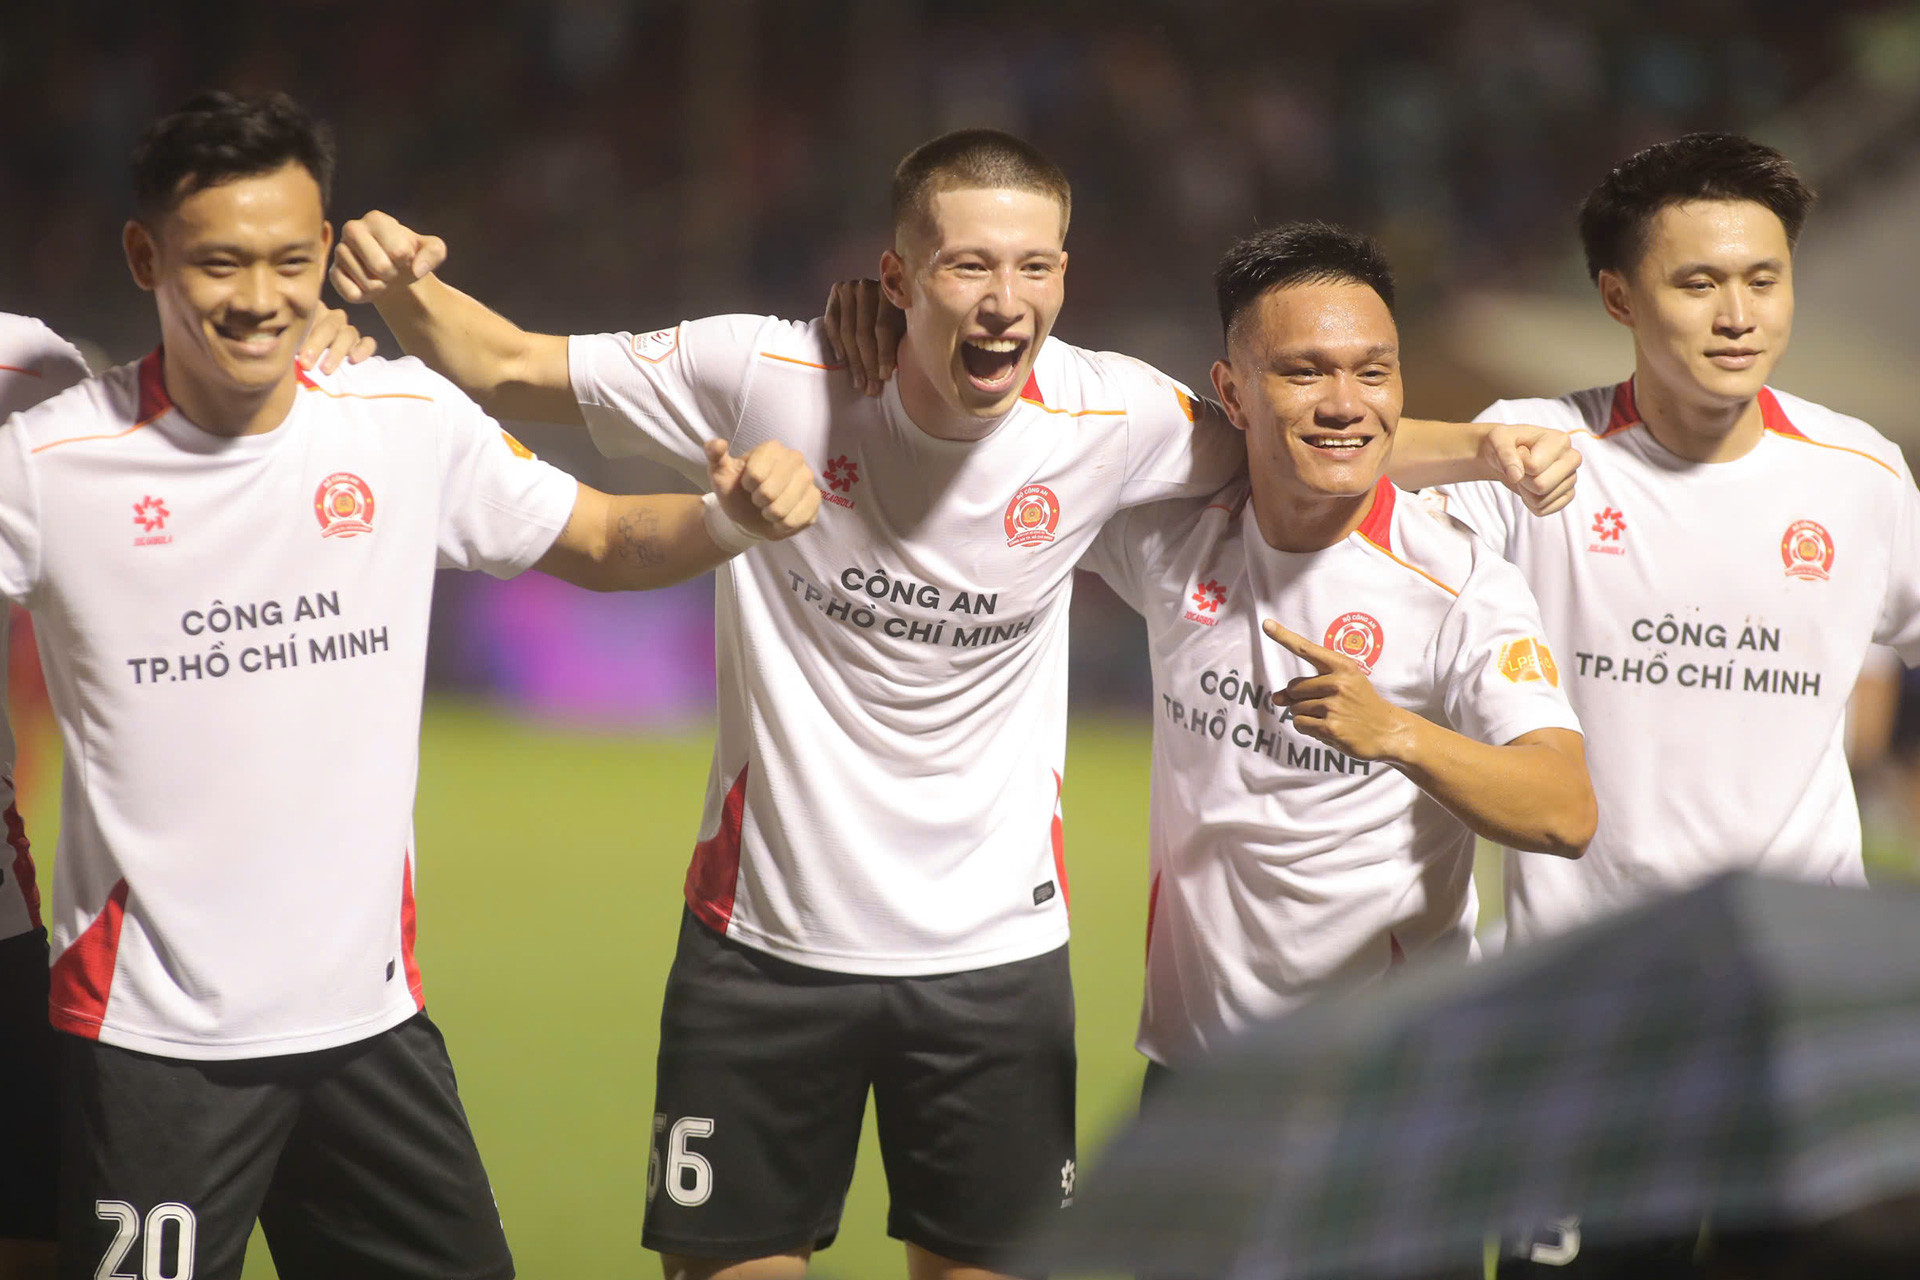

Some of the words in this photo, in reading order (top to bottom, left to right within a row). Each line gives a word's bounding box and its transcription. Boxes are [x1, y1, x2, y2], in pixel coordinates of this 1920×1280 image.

[181, 600, 283, 636] CÔNG
[294, 590, 341, 622] AN
[841, 568, 941, 609] CÔNG
[949, 592, 998, 615] AN
[127, 641, 230, 684] TP.HỒ
[239, 633, 299, 673] CHÍ
[308, 626, 390, 664] MINH
[883, 618, 948, 645] CHÍ
[951, 617, 1036, 648] MINH
[1631, 613, 1727, 649] CÔNG
[1736, 626, 1781, 652] AN
[1575, 651, 1669, 685] TP.HỒ
[1677, 659, 1736, 690] CHÍ
[1743, 667, 1822, 697] MINH
[1162, 692, 1228, 740] TP.HỒ
[1232, 723, 1283, 761] CHÍ
[1287, 742, 1370, 776] MINH
[93, 1199, 197, 1280] 20
